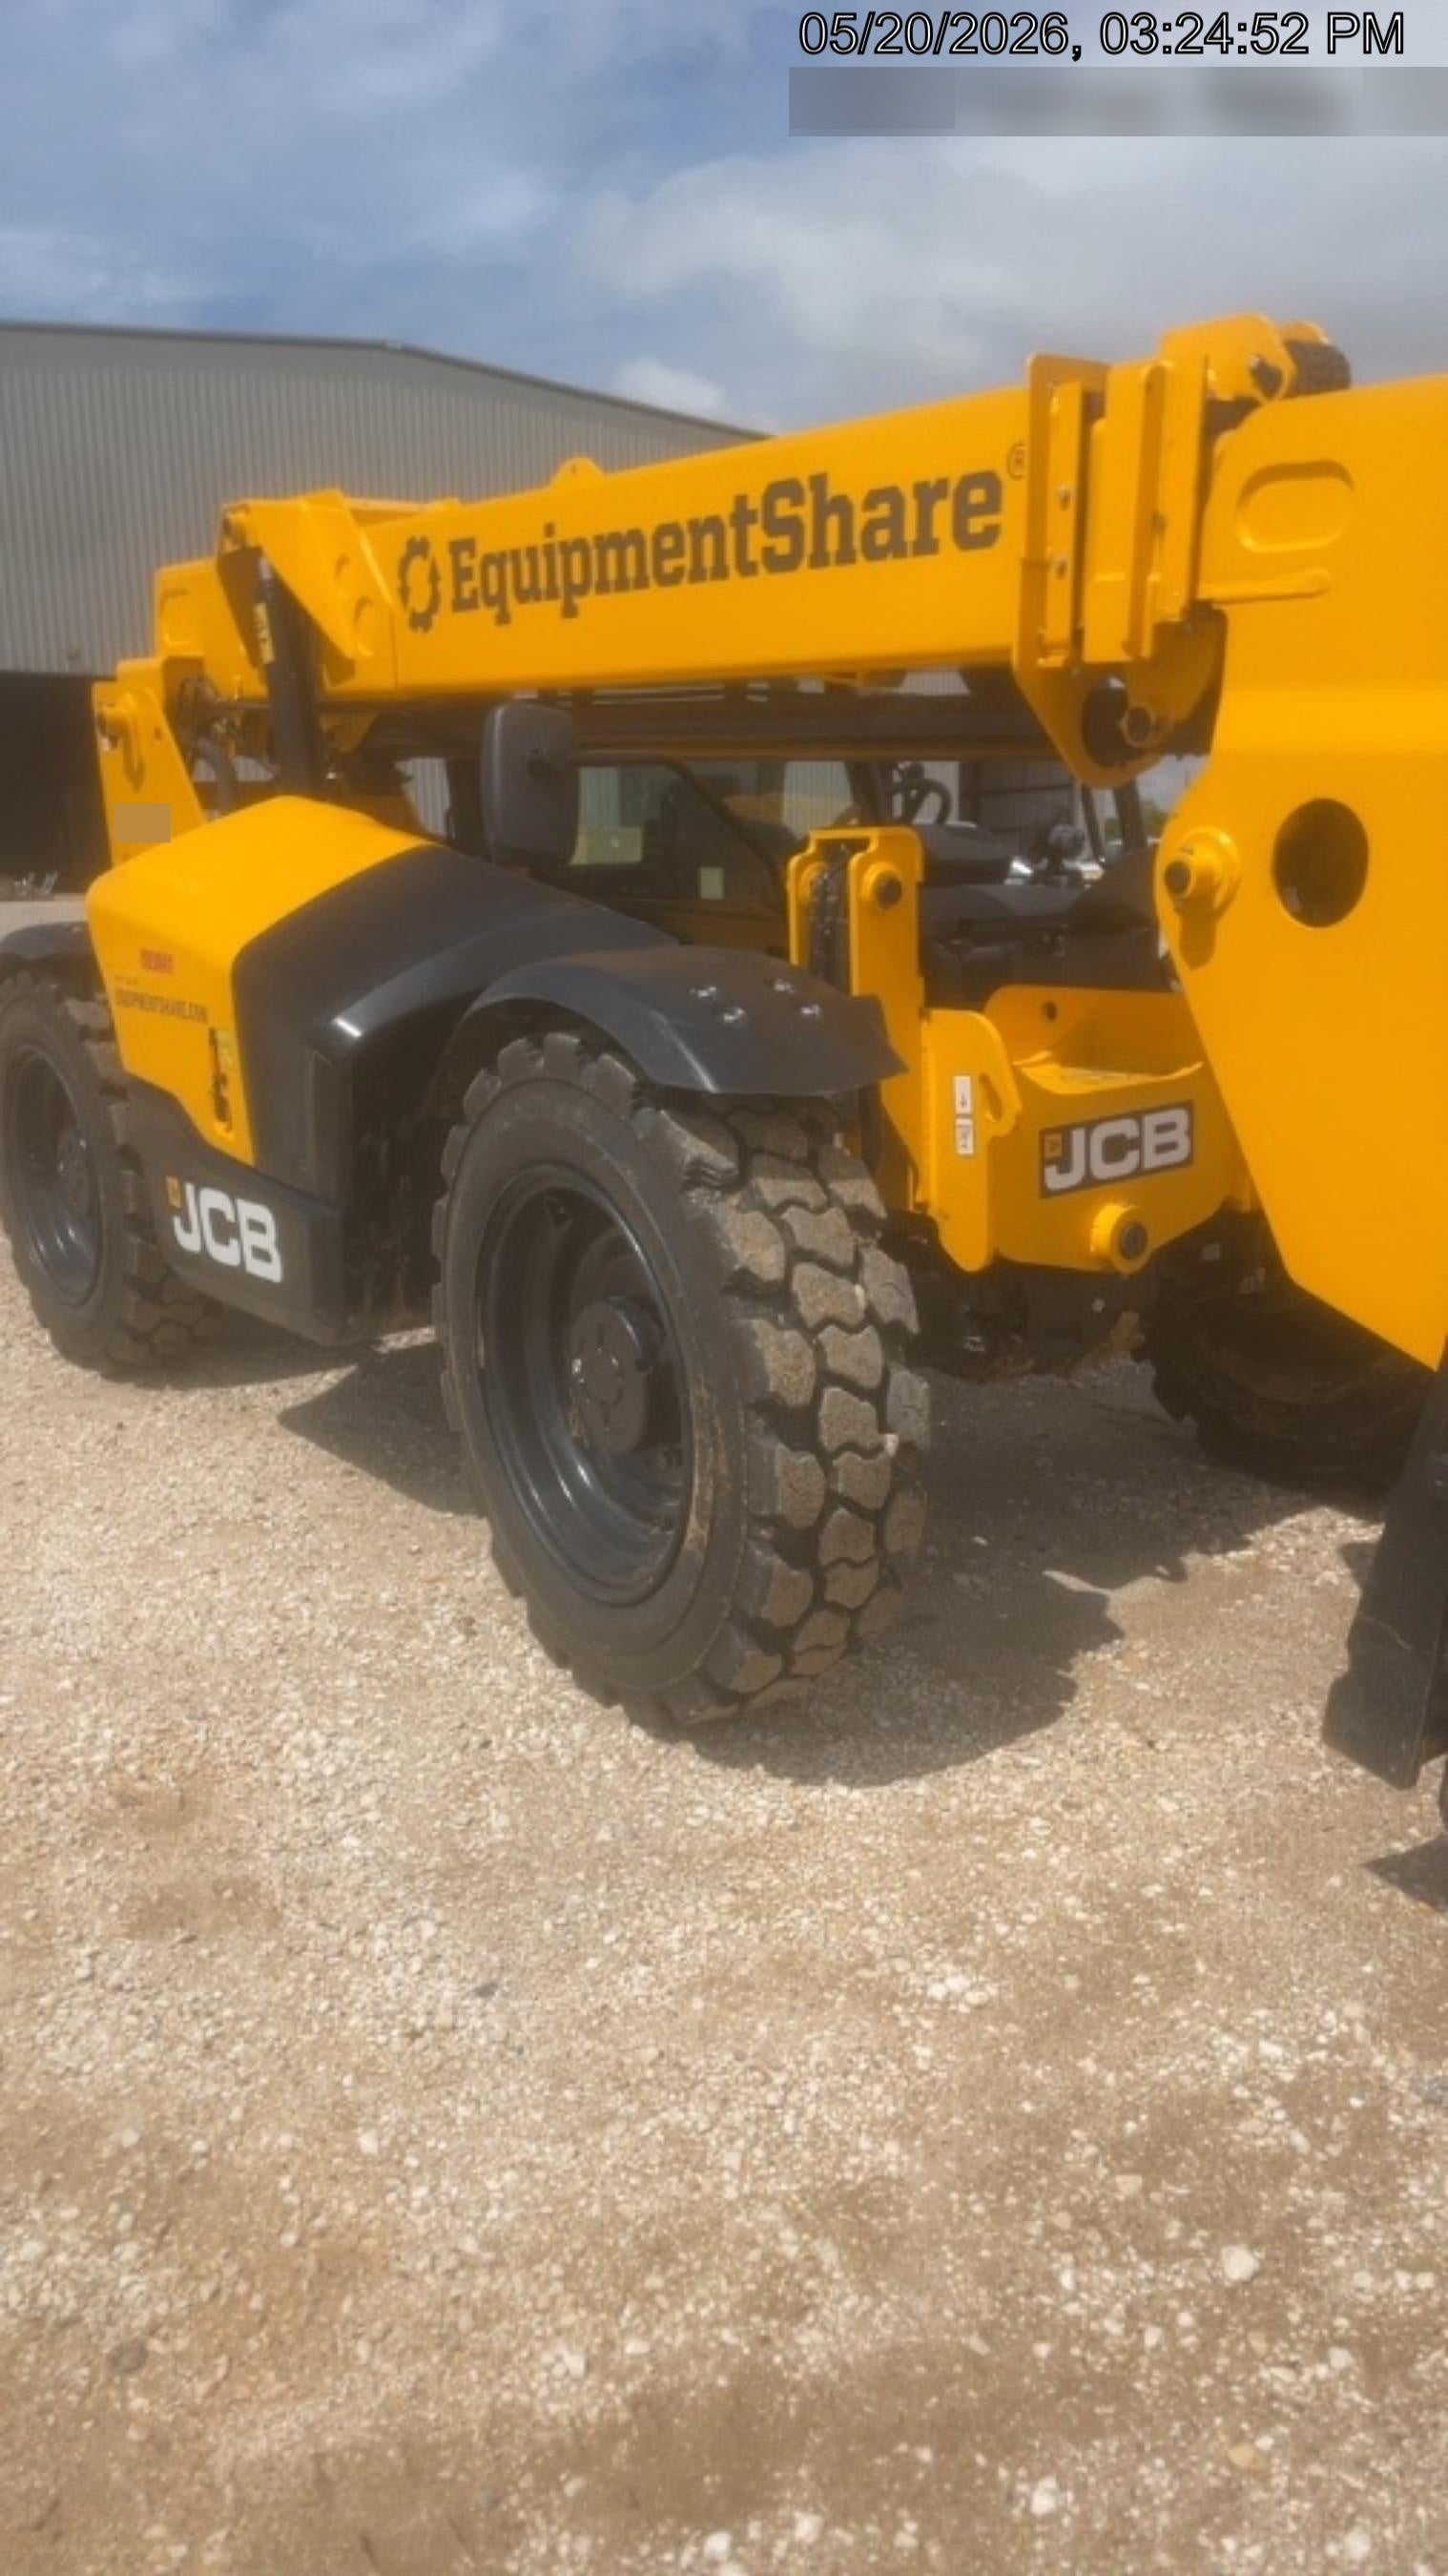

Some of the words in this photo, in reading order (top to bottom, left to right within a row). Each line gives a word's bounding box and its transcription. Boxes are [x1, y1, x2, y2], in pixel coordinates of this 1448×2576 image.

[448, 470, 1003, 626] EquipmentShare
[1044, 1107, 1191, 1192] JCB
[173, 1181, 282, 1283] JCB
